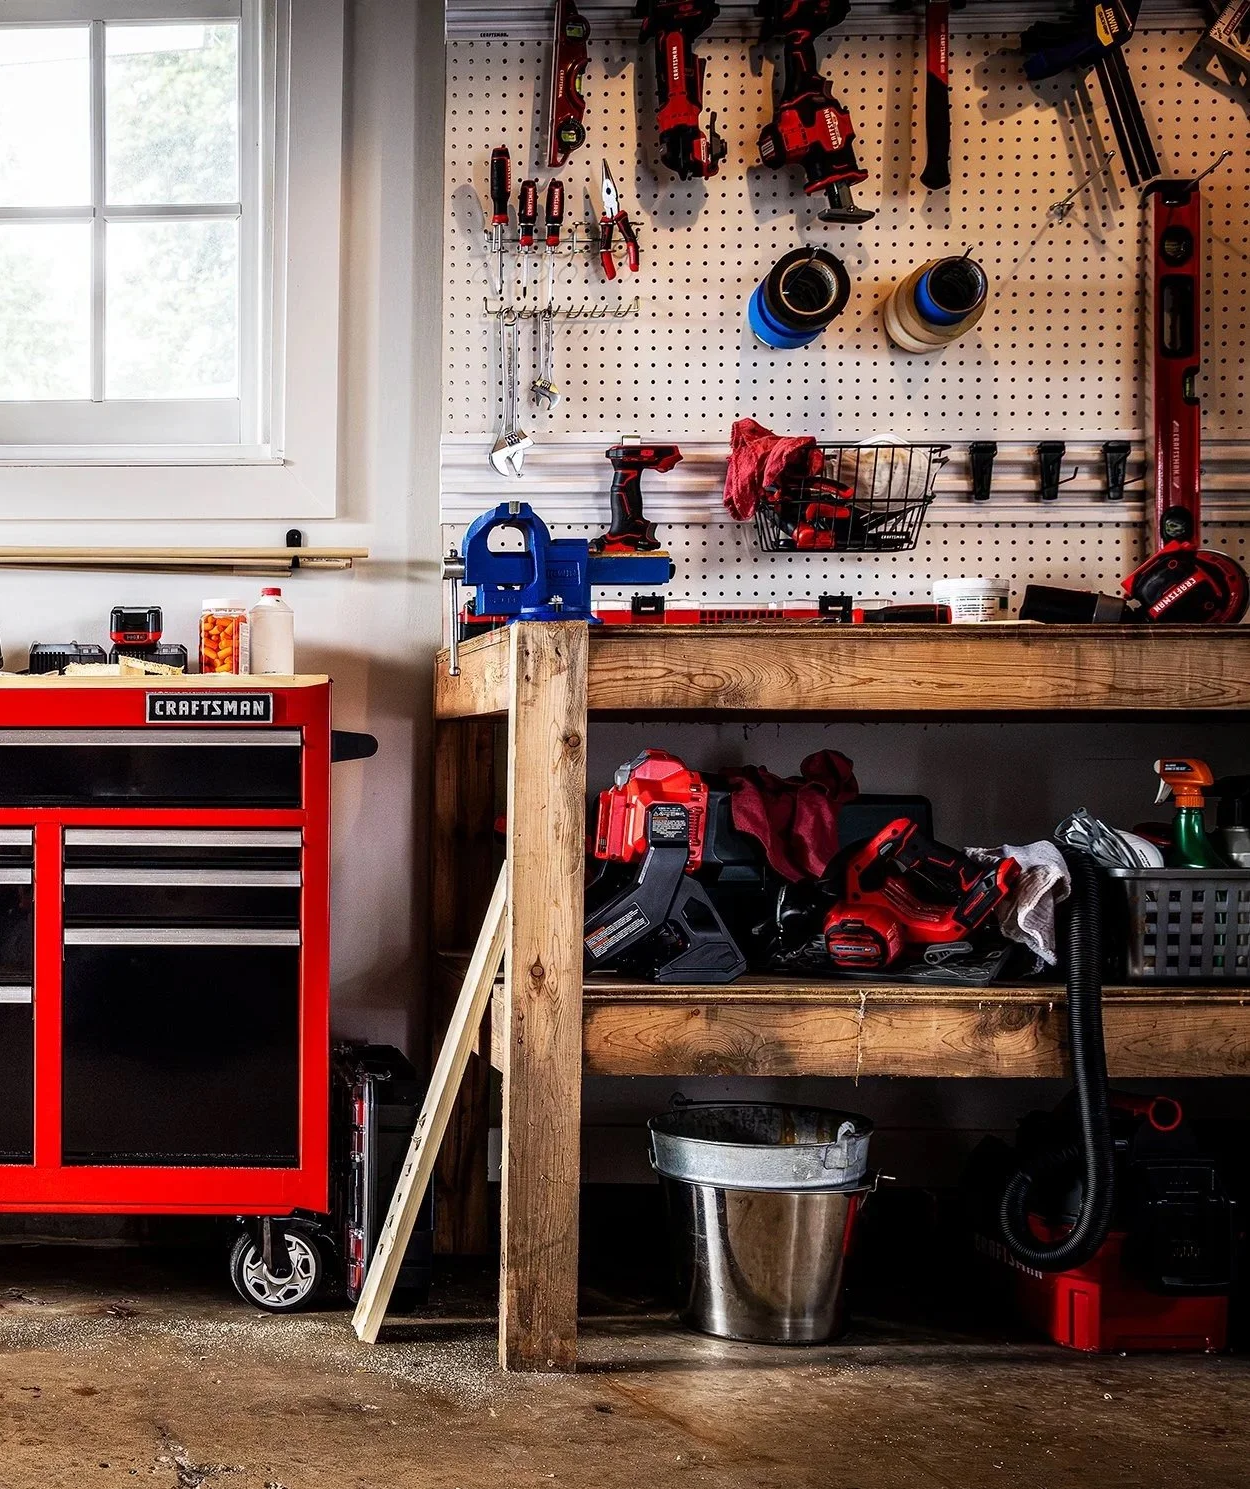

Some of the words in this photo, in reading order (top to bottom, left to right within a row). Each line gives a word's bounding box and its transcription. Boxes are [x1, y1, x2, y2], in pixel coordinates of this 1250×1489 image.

[1105, 8, 1119, 33] IRWIN
[672, 46, 680, 81] CRAFTSMAN
[823, 108, 840, 150] CRAFTSMAN
[1172, 433, 1181, 476] CRAFTSMAN
[1152, 577, 1197, 613] CRAFTSMAN
[154, 700, 265, 716] CRAFTSMAN
